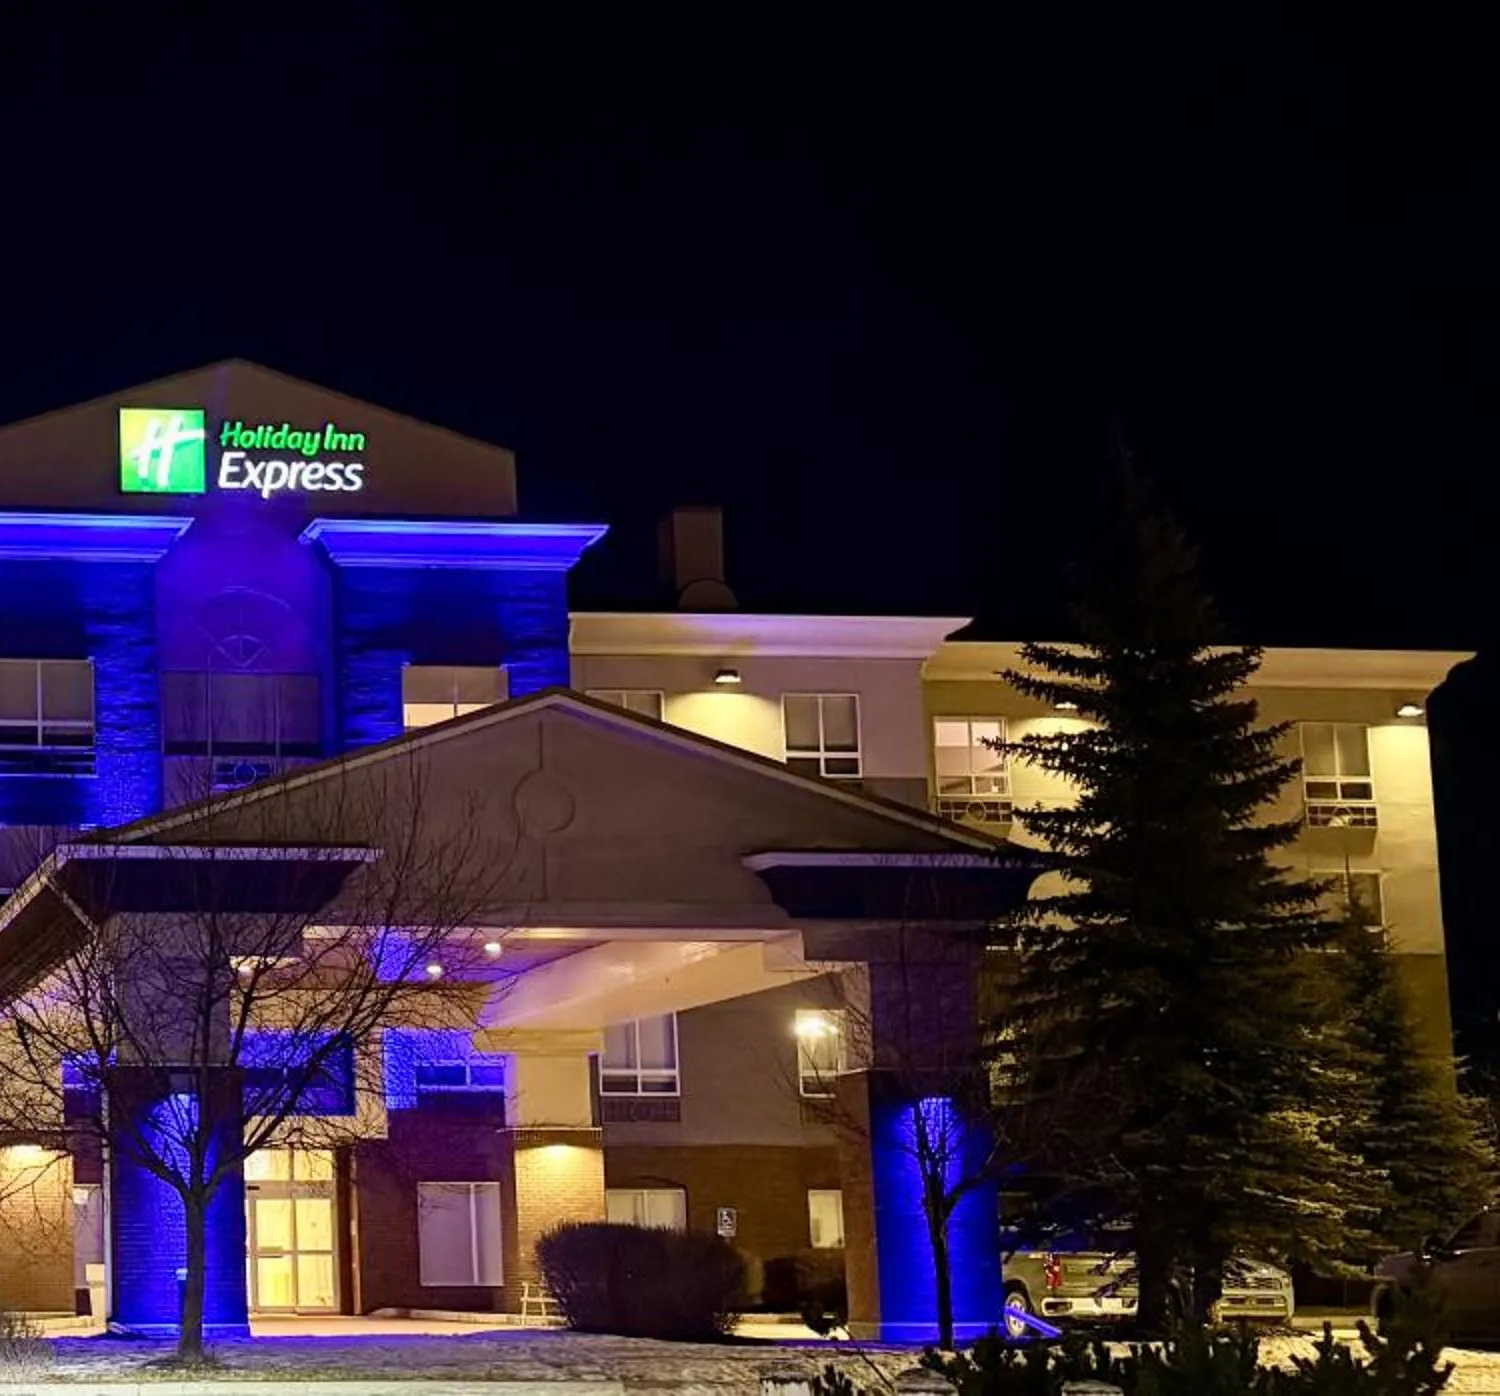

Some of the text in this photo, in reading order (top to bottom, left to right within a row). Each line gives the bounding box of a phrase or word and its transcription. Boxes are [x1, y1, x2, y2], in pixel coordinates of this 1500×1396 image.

[131, 414, 204, 488] H
[220, 421, 365, 456] Holiday Inn
[218, 451, 364, 499] Express
